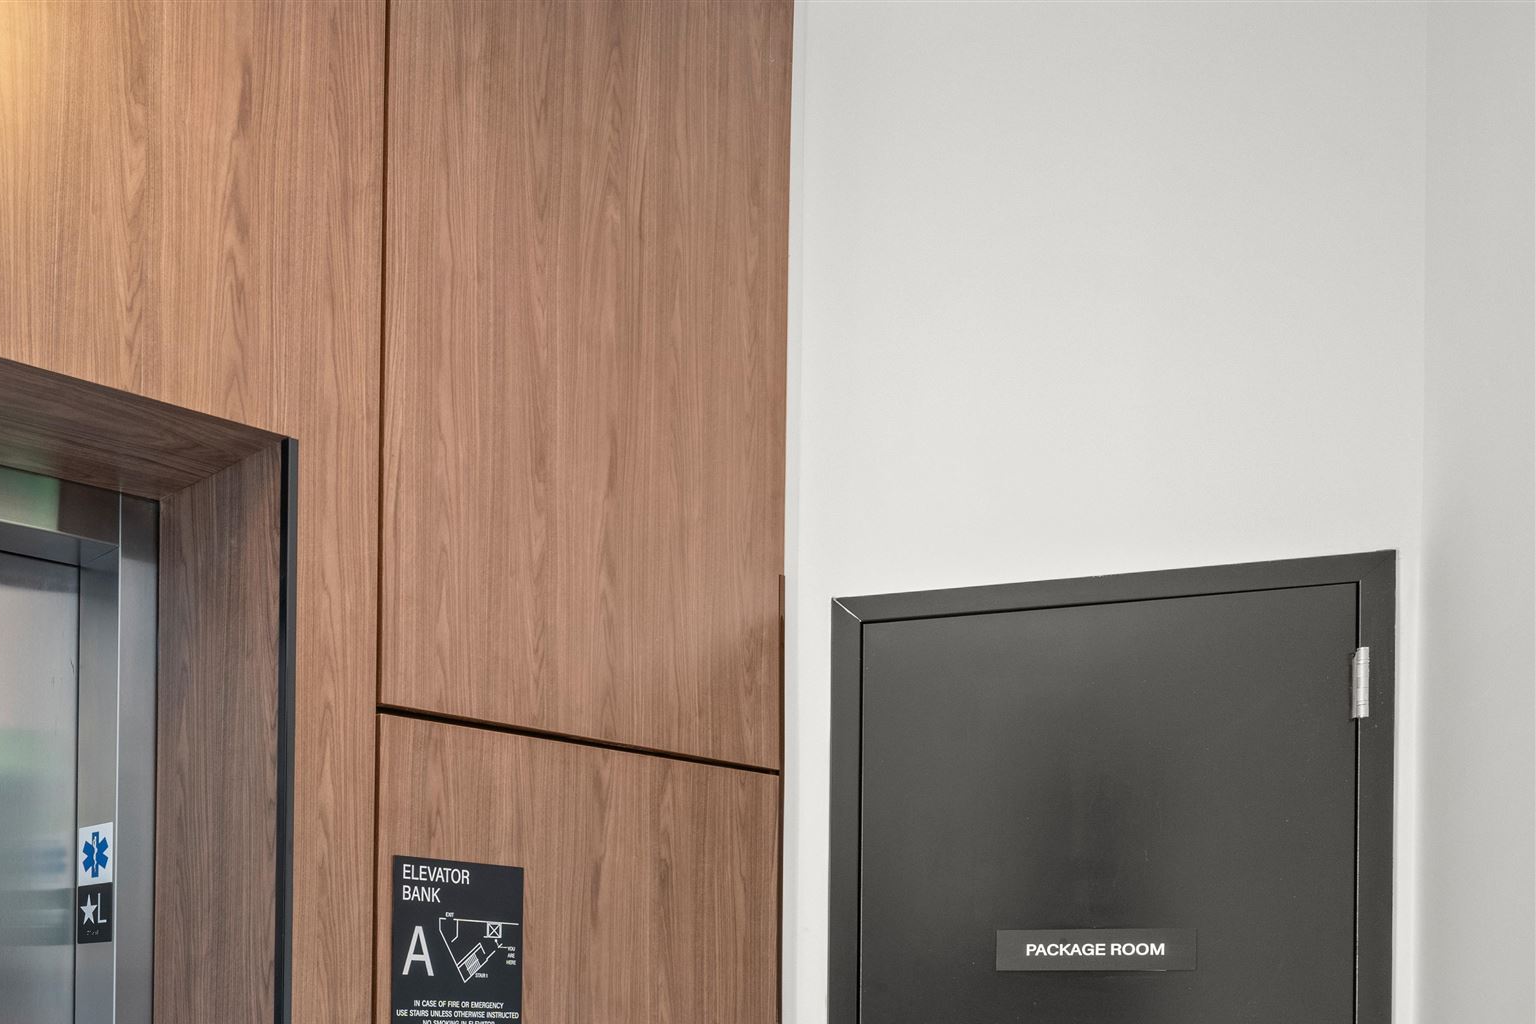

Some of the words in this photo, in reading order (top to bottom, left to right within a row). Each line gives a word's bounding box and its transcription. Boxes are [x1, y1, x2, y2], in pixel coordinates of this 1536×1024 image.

[402, 864, 470, 885] ELEVATOR
[402, 885, 441, 903] BANK
[97, 892, 107, 924] L
[402, 925, 434, 976] A
[1026, 943, 1106, 957] PACKAGE
[1110, 943, 1165, 956] ROOM
[431, 1010, 452, 1018] UNLESS
[487, 1011, 519, 1019] INSTRUCTED
